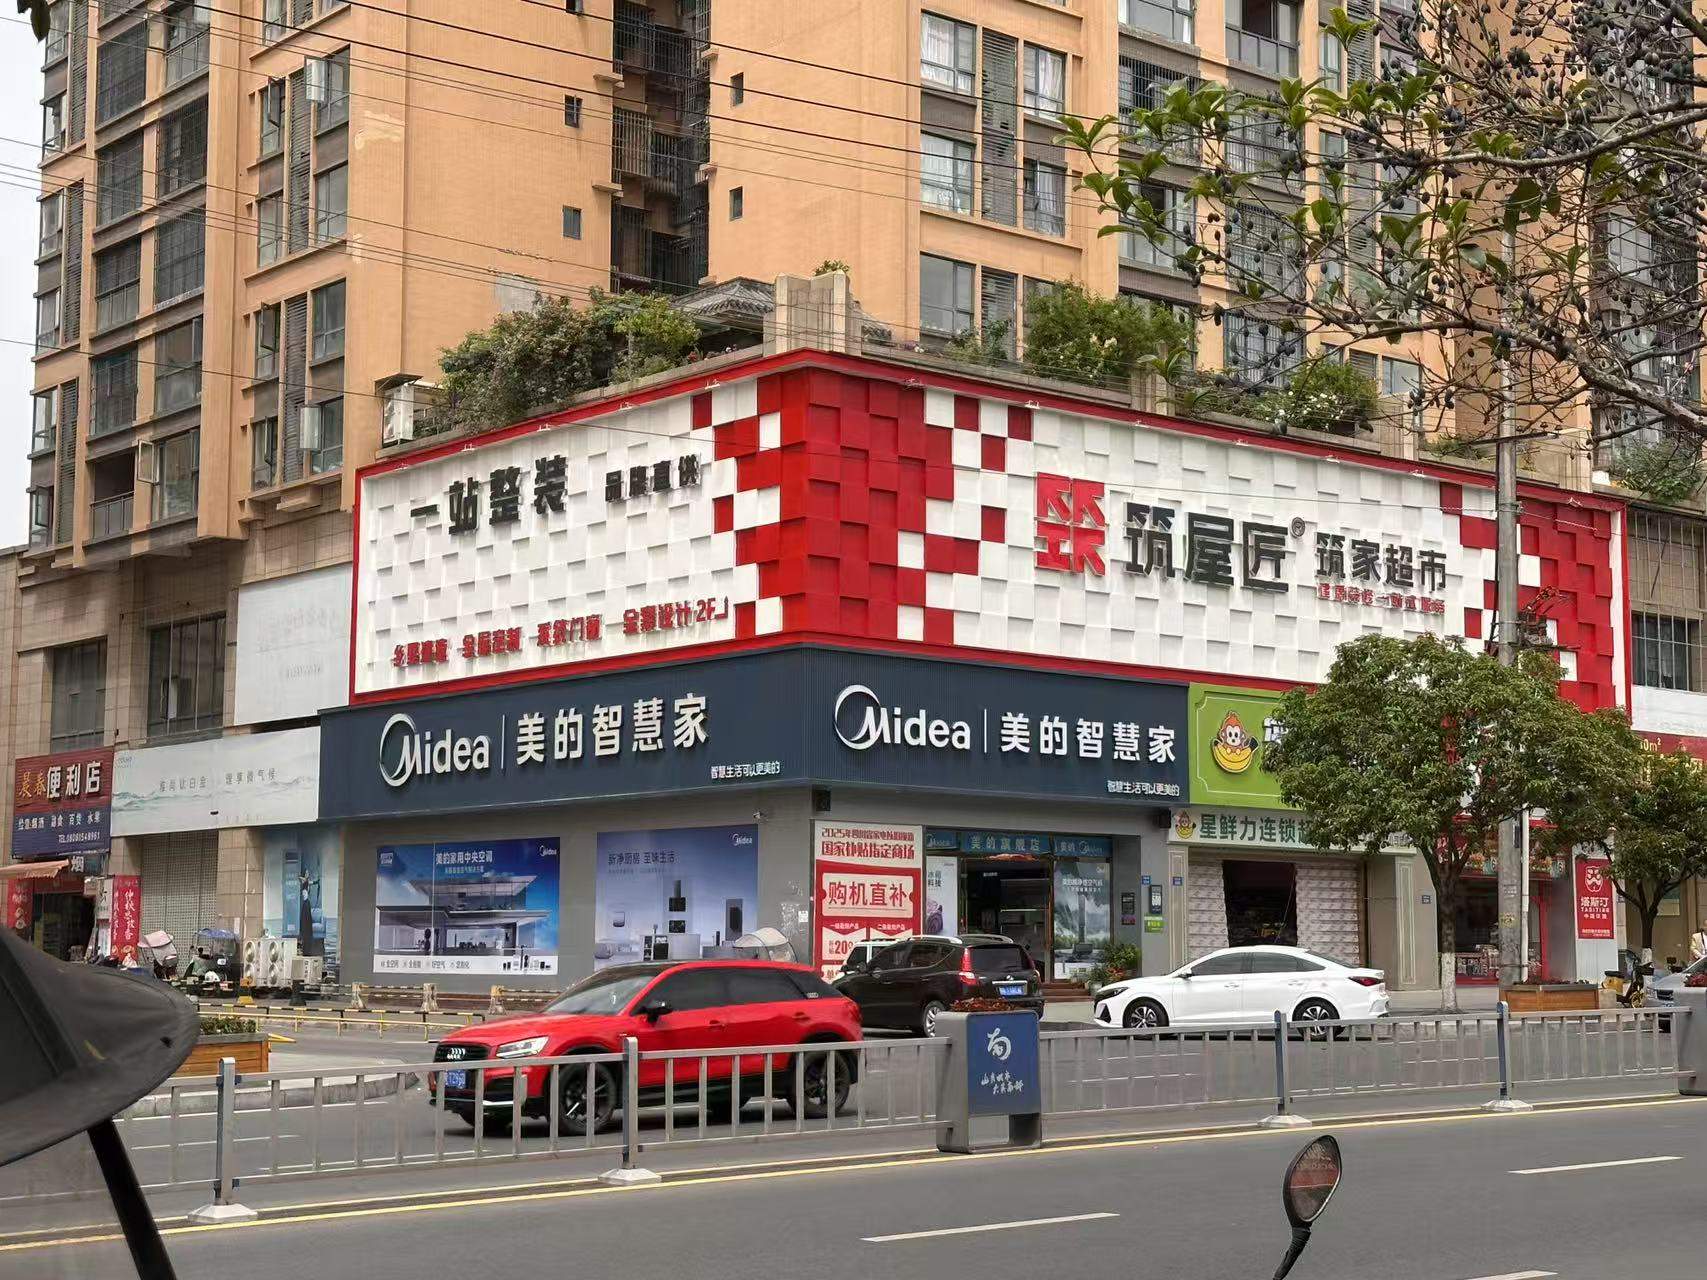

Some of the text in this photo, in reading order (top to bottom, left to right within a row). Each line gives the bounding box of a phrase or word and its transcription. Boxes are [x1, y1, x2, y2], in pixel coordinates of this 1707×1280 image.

[410, 453, 569, 535] 一站整装
[1123, 500, 1289, 593] 筑屋匠
[1315, 531, 1447, 592] 筑家超市
[834, 684, 971, 751] Midea
[515, 693, 708, 766] 美的智慧家
[1000, 711, 1177, 764] 美的智慧家
[379, 712, 490, 788] Midea
[710, 760, 781, 779] 智慧生活可以更美的
[1107, 780, 1180, 797] 智慧生活可以更美的
[732, 833, 753, 847] Midea
[821, 840, 915, 860] 国家补贴指定商场
[971, 836, 1041, 851] 美的旗舰店
[71, 855, 85, 873] 烟
[435, 850, 493, 865] 美的家用中央空调
[828, 881, 908, 908] 购机直补
[1580, 896, 1609, 908] 塔斯汀
